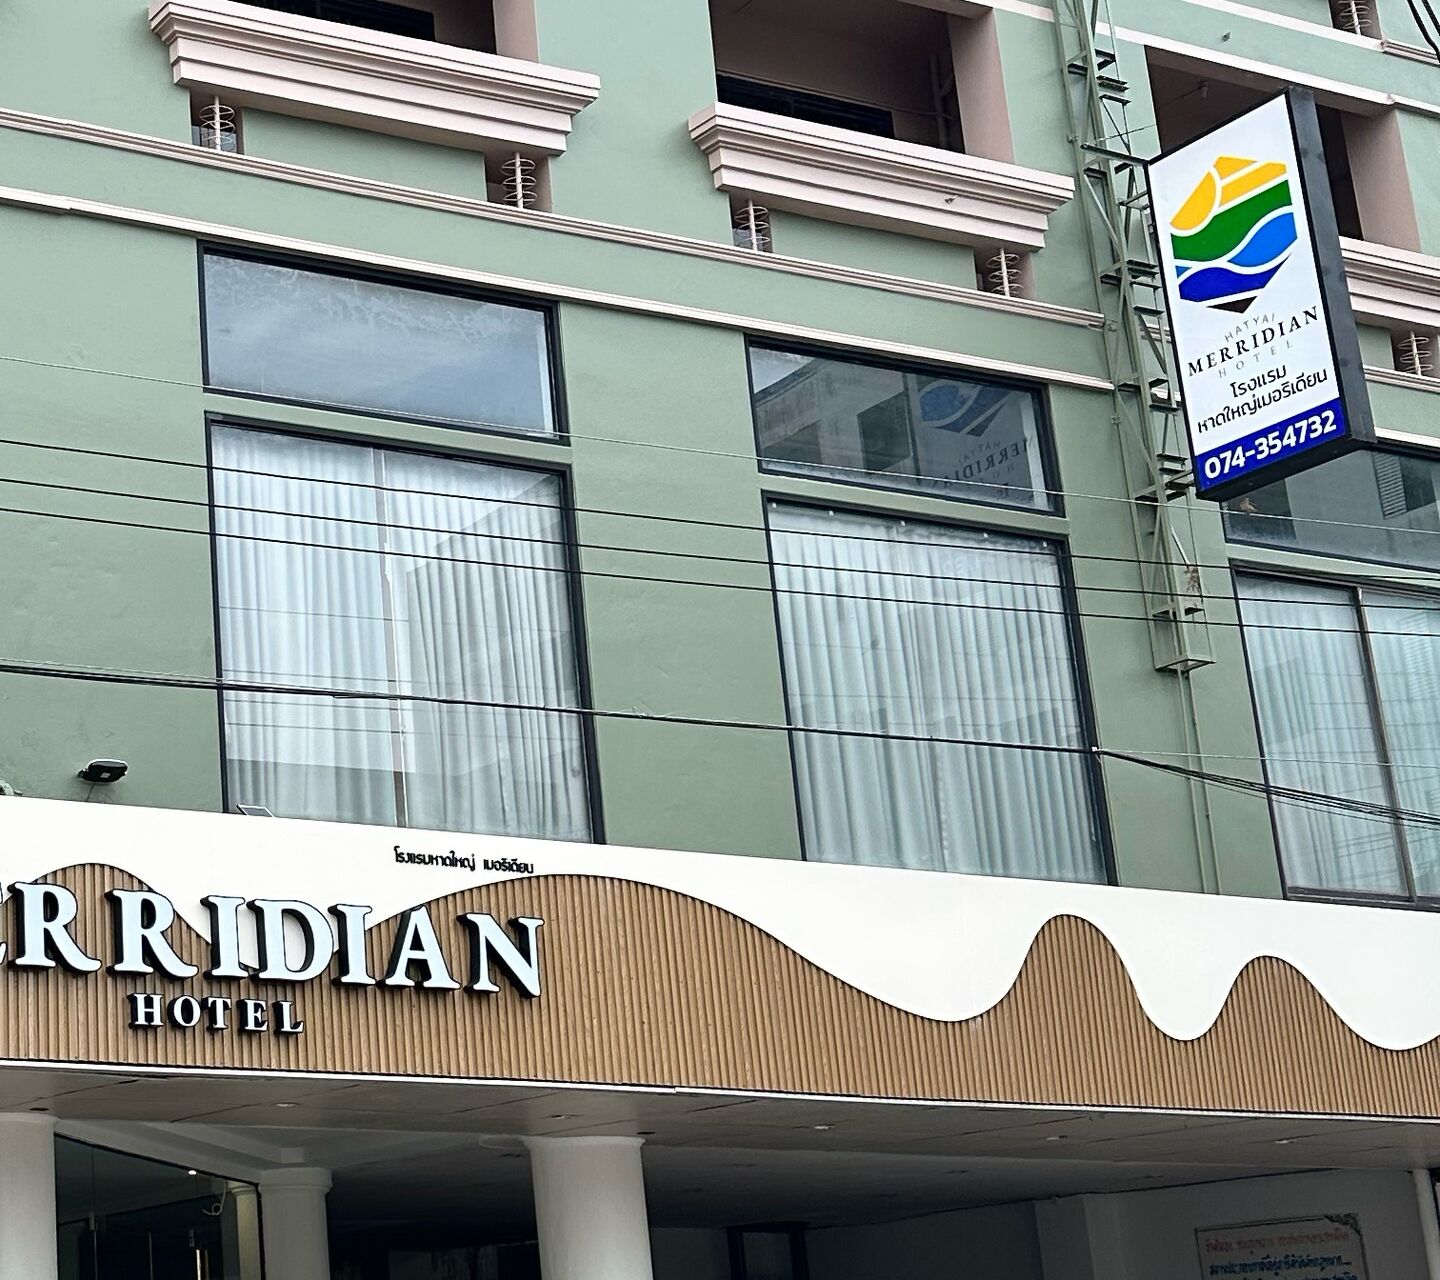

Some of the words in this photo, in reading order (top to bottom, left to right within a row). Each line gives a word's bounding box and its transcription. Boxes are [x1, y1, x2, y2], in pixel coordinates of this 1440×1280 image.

[1188, 305, 1318, 377] MERRIDIAN
[1223, 313, 1275, 342] HATYAI
[1218, 340, 1294, 378] HOTEL
[1230, 364, 1287, 398] โรงแรม
[1204, 409, 1337, 479] 074-354732
[393, 845, 476, 872] โรงแรมหาดใหญ่
[128, 992, 304, 1034] HOTEL
